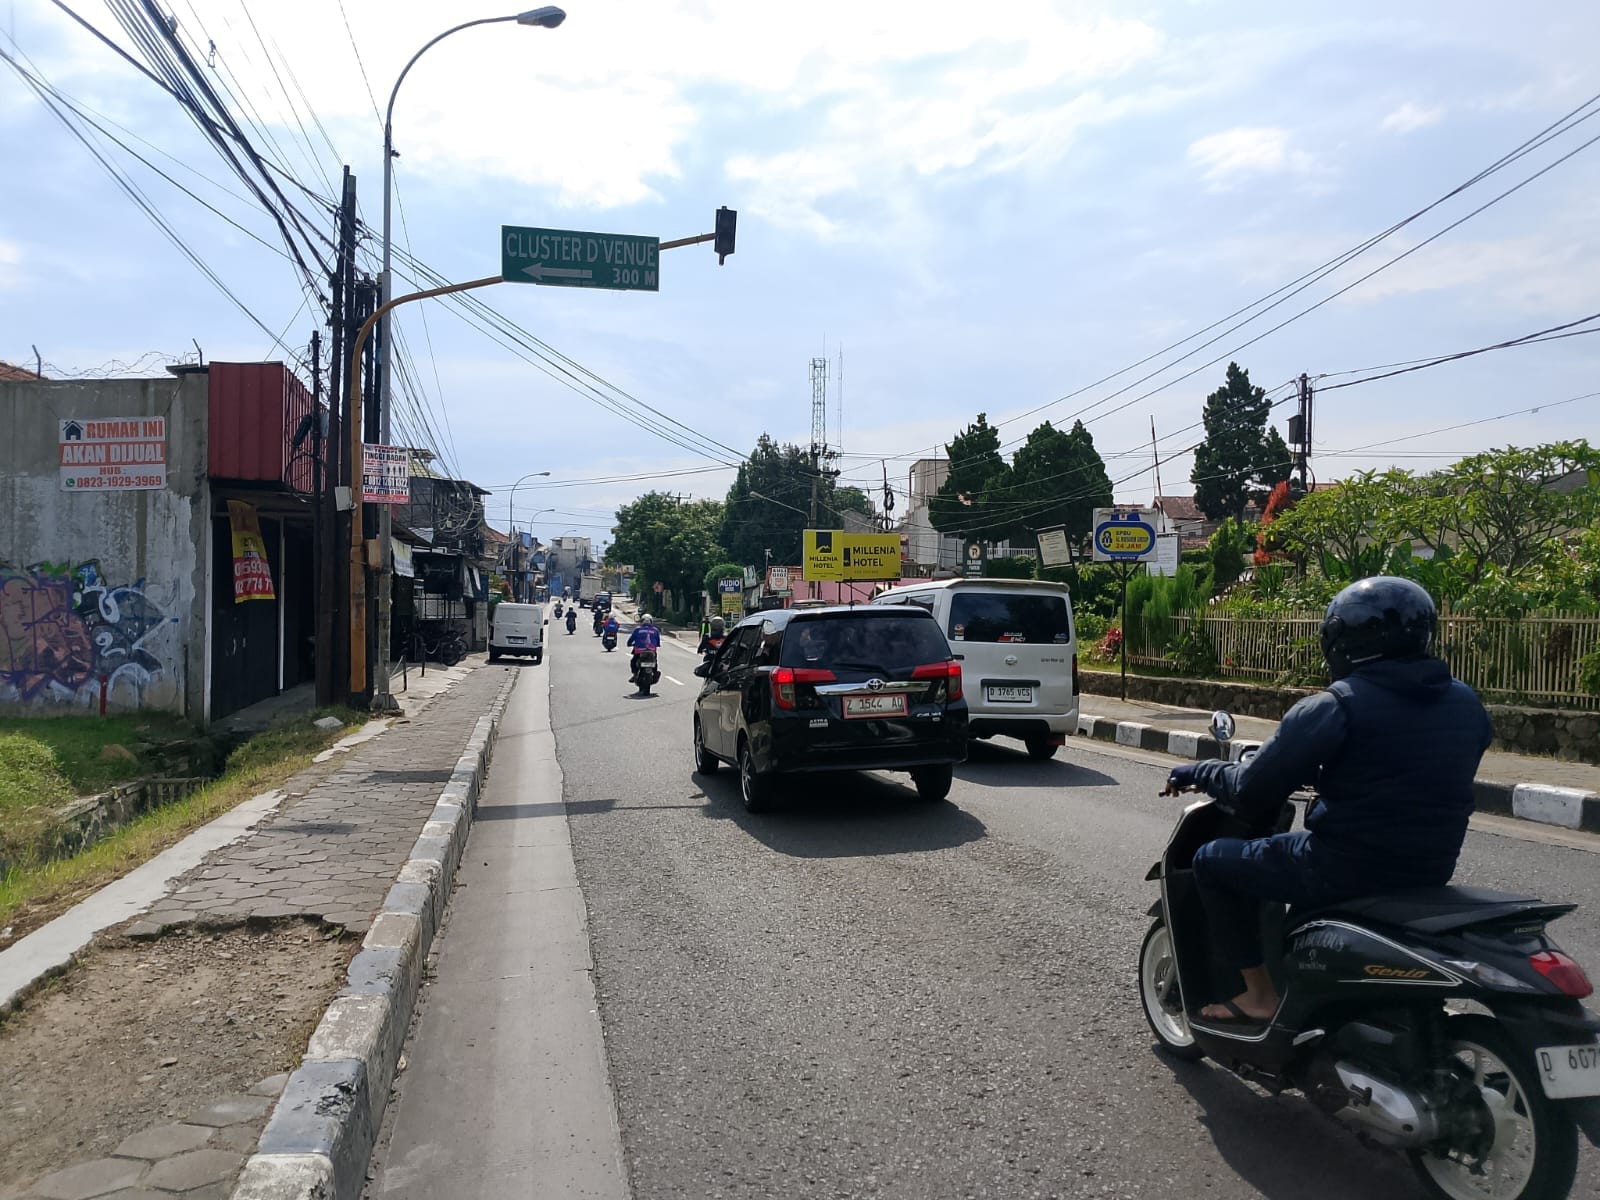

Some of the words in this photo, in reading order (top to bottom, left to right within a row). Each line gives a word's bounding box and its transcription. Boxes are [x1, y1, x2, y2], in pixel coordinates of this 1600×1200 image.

[505, 233, 583, 262] CLUSTER
[587, 238, 656, 267] D'VENUE
[612, 267, 639, 285] 300
[644, 270, 656, 286] M
[86, 421, 139, 439] RUMAH
[143, 420, 163, 437] INI
[62, 444, 106, 464] AKAN
[109, 443, 163, 463] DIJUAL
[365, 452, 385, 460] TINGGI
[99, 466, 122, 475] HUB
[77, 476, 162, 488] 0823-1929-3969
[853, 546, 896, 555] MILLENIA
[853, 558, 884, 567] HOTEL
[719, 579, 740, 587] AUDIO
[989, 688, 995, 697] D
[846, 700, 852, 710] Z
[859, 699, 882, 710] 1544
[1363, 965, 1430, 979] Genio
[1541, 1051, 1553, 1073] D
